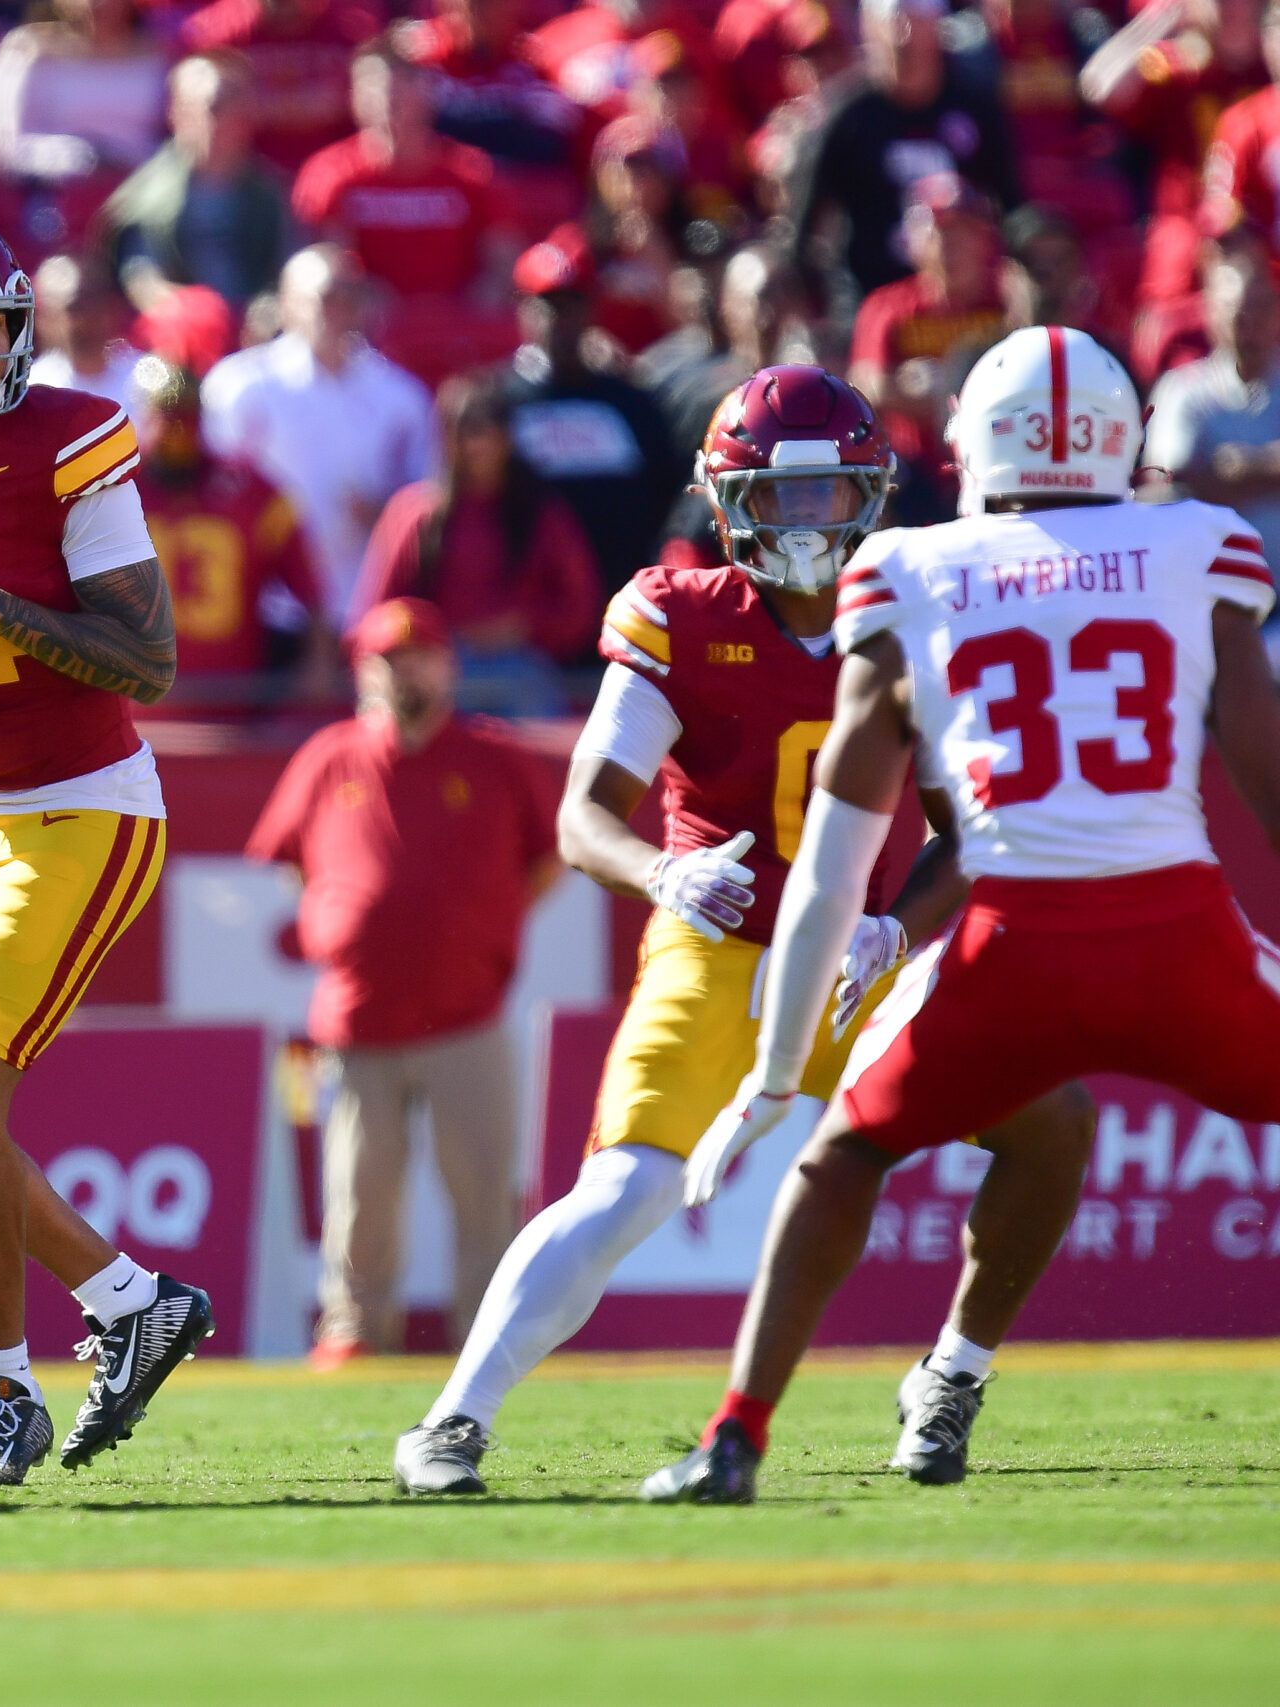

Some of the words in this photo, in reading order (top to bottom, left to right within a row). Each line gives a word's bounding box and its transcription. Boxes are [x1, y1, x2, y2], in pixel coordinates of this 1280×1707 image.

[1025, 412, 1094, 452] 33
[952, 568, 981, 612] J.
[993, 549, 1151, 602] WRIGHT
[947, 618, 1176, 810] 33
[862, 1200, 1170, 1262] RERT
